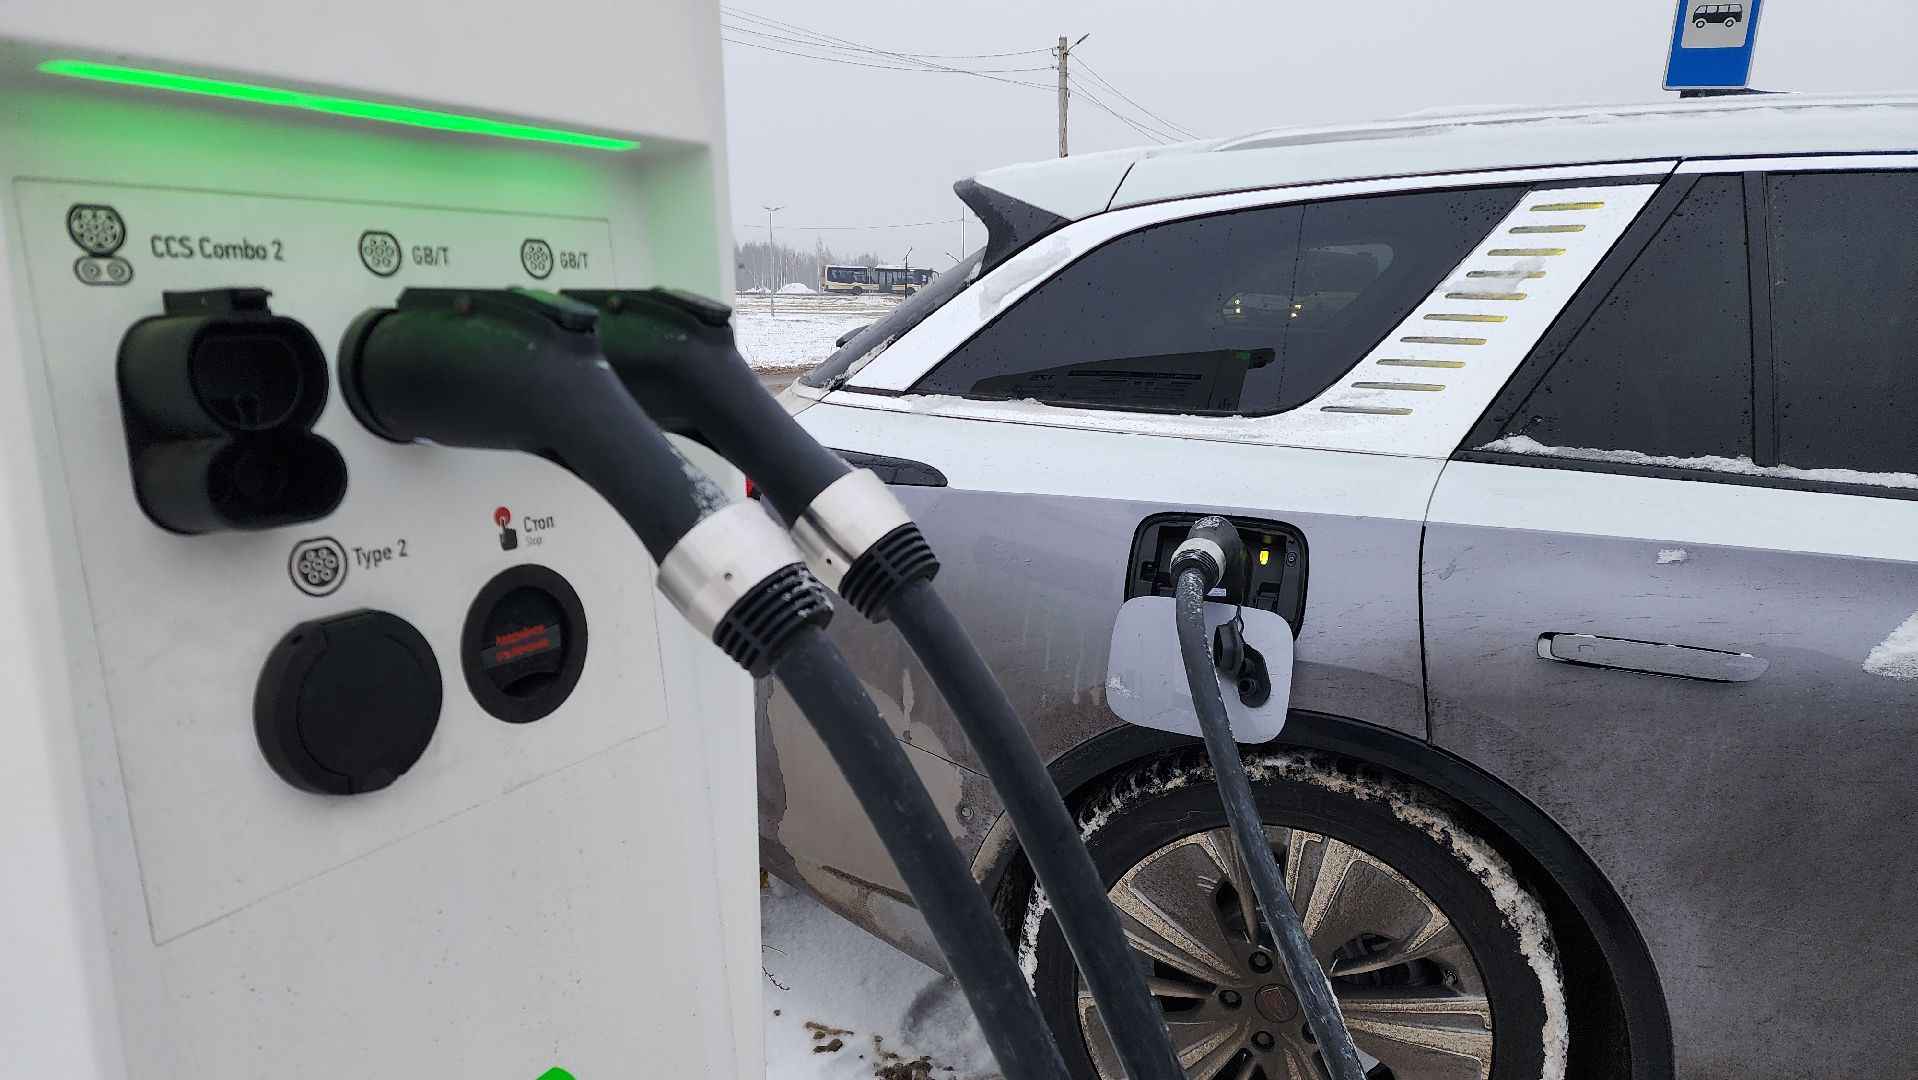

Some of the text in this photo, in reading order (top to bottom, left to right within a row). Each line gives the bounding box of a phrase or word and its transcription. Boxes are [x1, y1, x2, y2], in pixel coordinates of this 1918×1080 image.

[151, 235, 283, 262] CCS Combo 2
[412, 245, 449, 266] GB/T
[560, 252, 589, 269] GB/T
[523, 516, 554, 533] Стоп
[525, 536, 543, 546] Stop
[354, 539, 408, 570] Type 2
